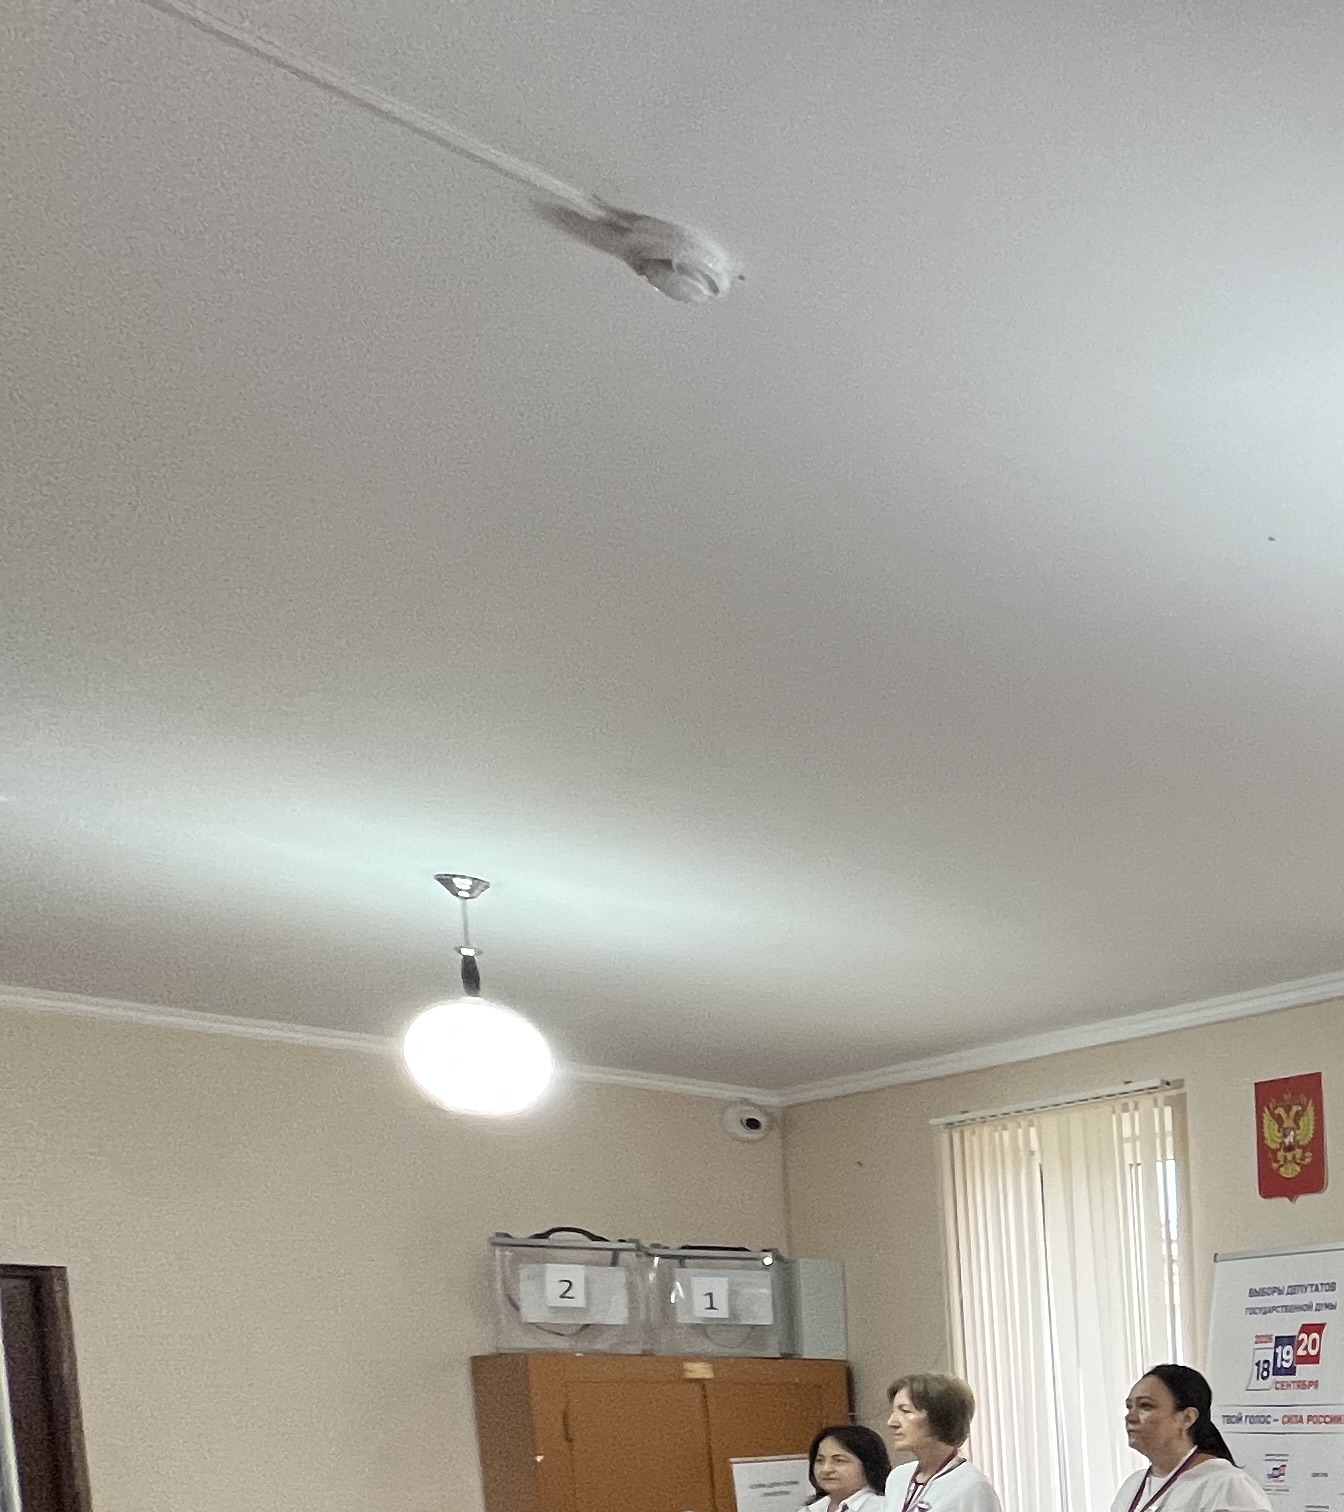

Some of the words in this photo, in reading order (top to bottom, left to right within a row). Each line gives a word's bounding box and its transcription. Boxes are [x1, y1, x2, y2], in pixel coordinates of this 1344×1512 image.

[557, 1279, 576, 1300] 2
[1286, 1281, 1337, 1296] ДЕПУТАТОВ
[703, 1291, 719, 1311] 1
[1255, 1359, 1271, 1381] 18
[1275, 1344, 1294, 1369] 19
[1296, 1332, 1320, 1356] 20
[1274, 1379, 1319, 1391] СЕНТЯБРЯ
